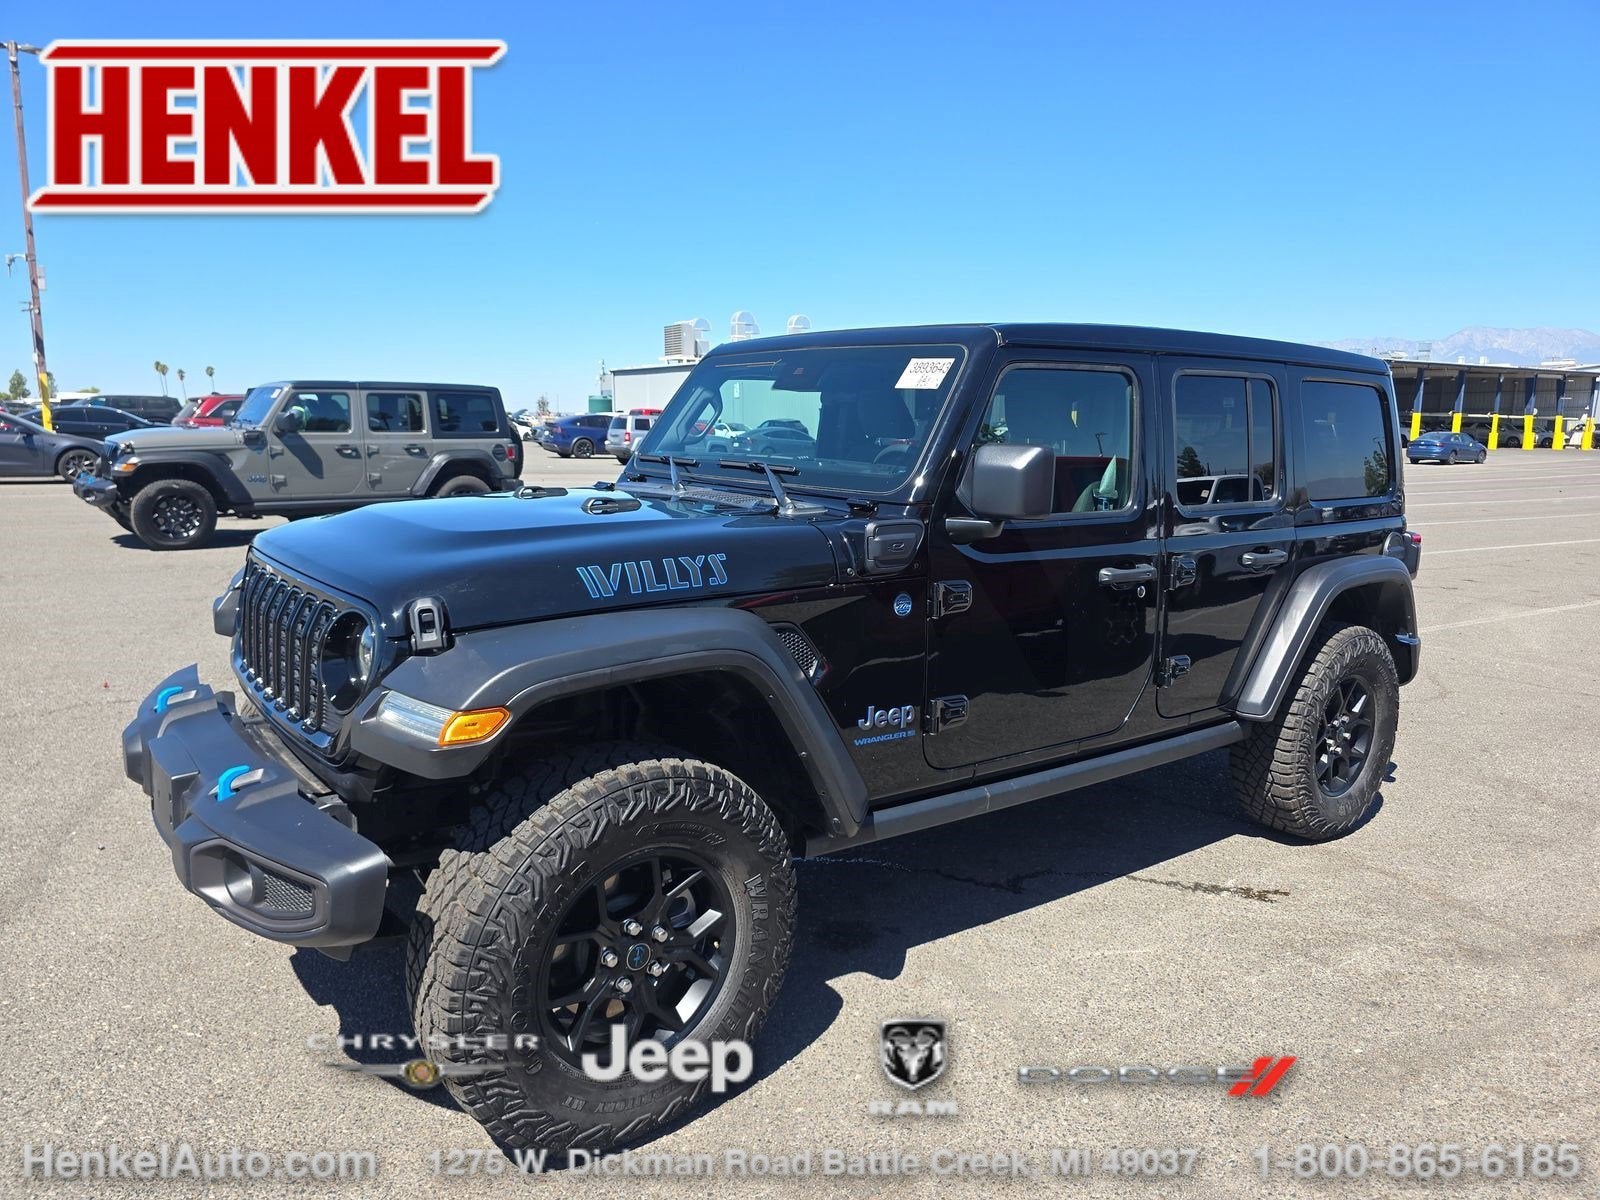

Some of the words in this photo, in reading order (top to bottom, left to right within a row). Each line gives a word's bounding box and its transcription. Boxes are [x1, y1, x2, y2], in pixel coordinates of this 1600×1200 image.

[576, 553, 728, 598] WILLYS
[857, 705, 915, 731] Jeep
[853, 731, 906, 747] WRANGLER
